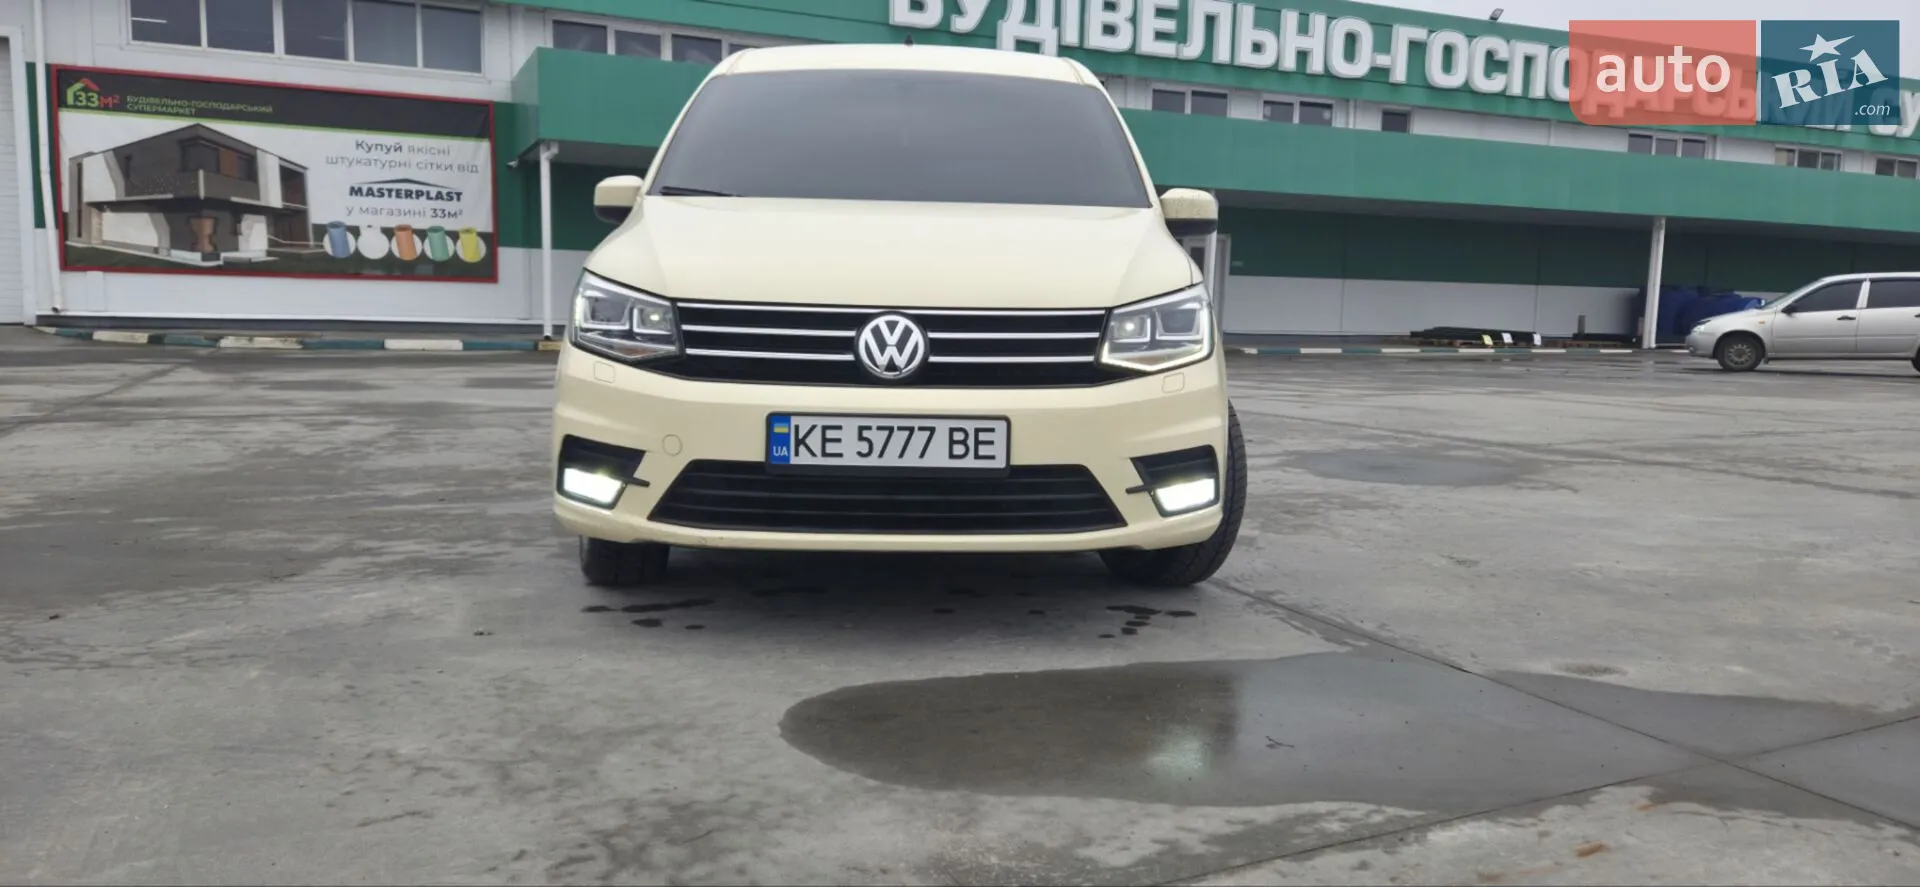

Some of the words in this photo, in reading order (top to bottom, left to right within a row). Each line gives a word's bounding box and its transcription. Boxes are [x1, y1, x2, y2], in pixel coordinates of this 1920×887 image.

[126, 95, 274, 114] БУДІВЕЛЬНО-ГОСПОДАРСЬКИЙ
[126, 103, 196, 116] СУПЕРМАРКЕТ
[355, 139, 403, 154] Купуй
[407, 144, 451, 157] якісні
[325, 155, 412, 170] штукатурні
[416, 159, 453, 171] сітки
[457, 163, 480, 174] від
[349, 186, 464, 202] MASTERPLAST
[346, 206, 354, 217] у
[359, 206, 426, 218] магазині
[794, 424, 844, 459] KE
[856, 425, 936, 459] 5777
[948, 427, 996, 460] BE
[773, 445, 788, 457] UA
